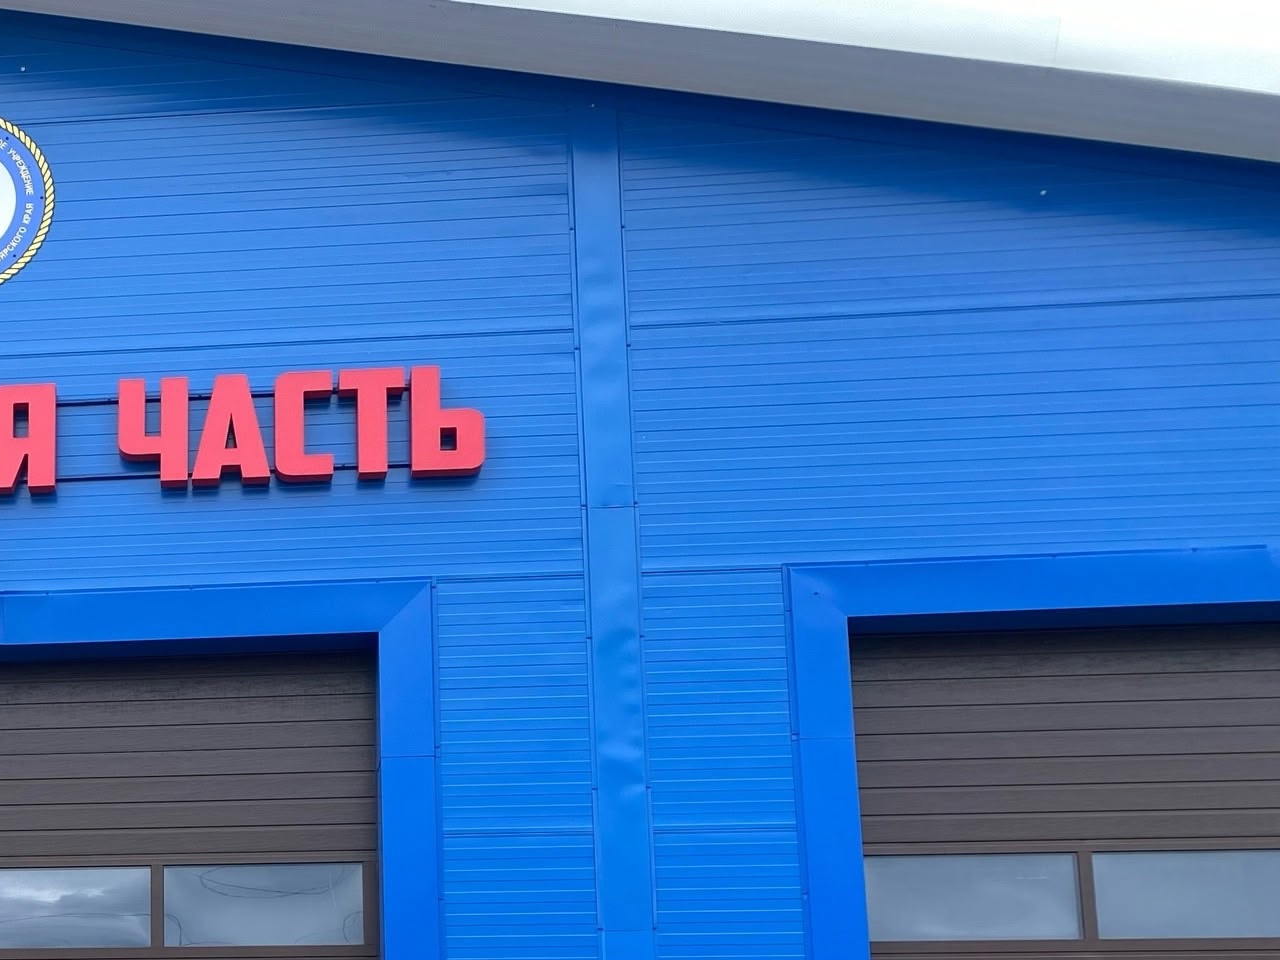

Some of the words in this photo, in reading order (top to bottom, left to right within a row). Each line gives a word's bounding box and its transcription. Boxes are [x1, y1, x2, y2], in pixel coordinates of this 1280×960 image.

[7, 147, 34, 195] УЧРЕЖДЕНИЕ
[23, 203, 34, 225] КРАЯ
[117, 365, 486, 488] ЧАСТЬ
